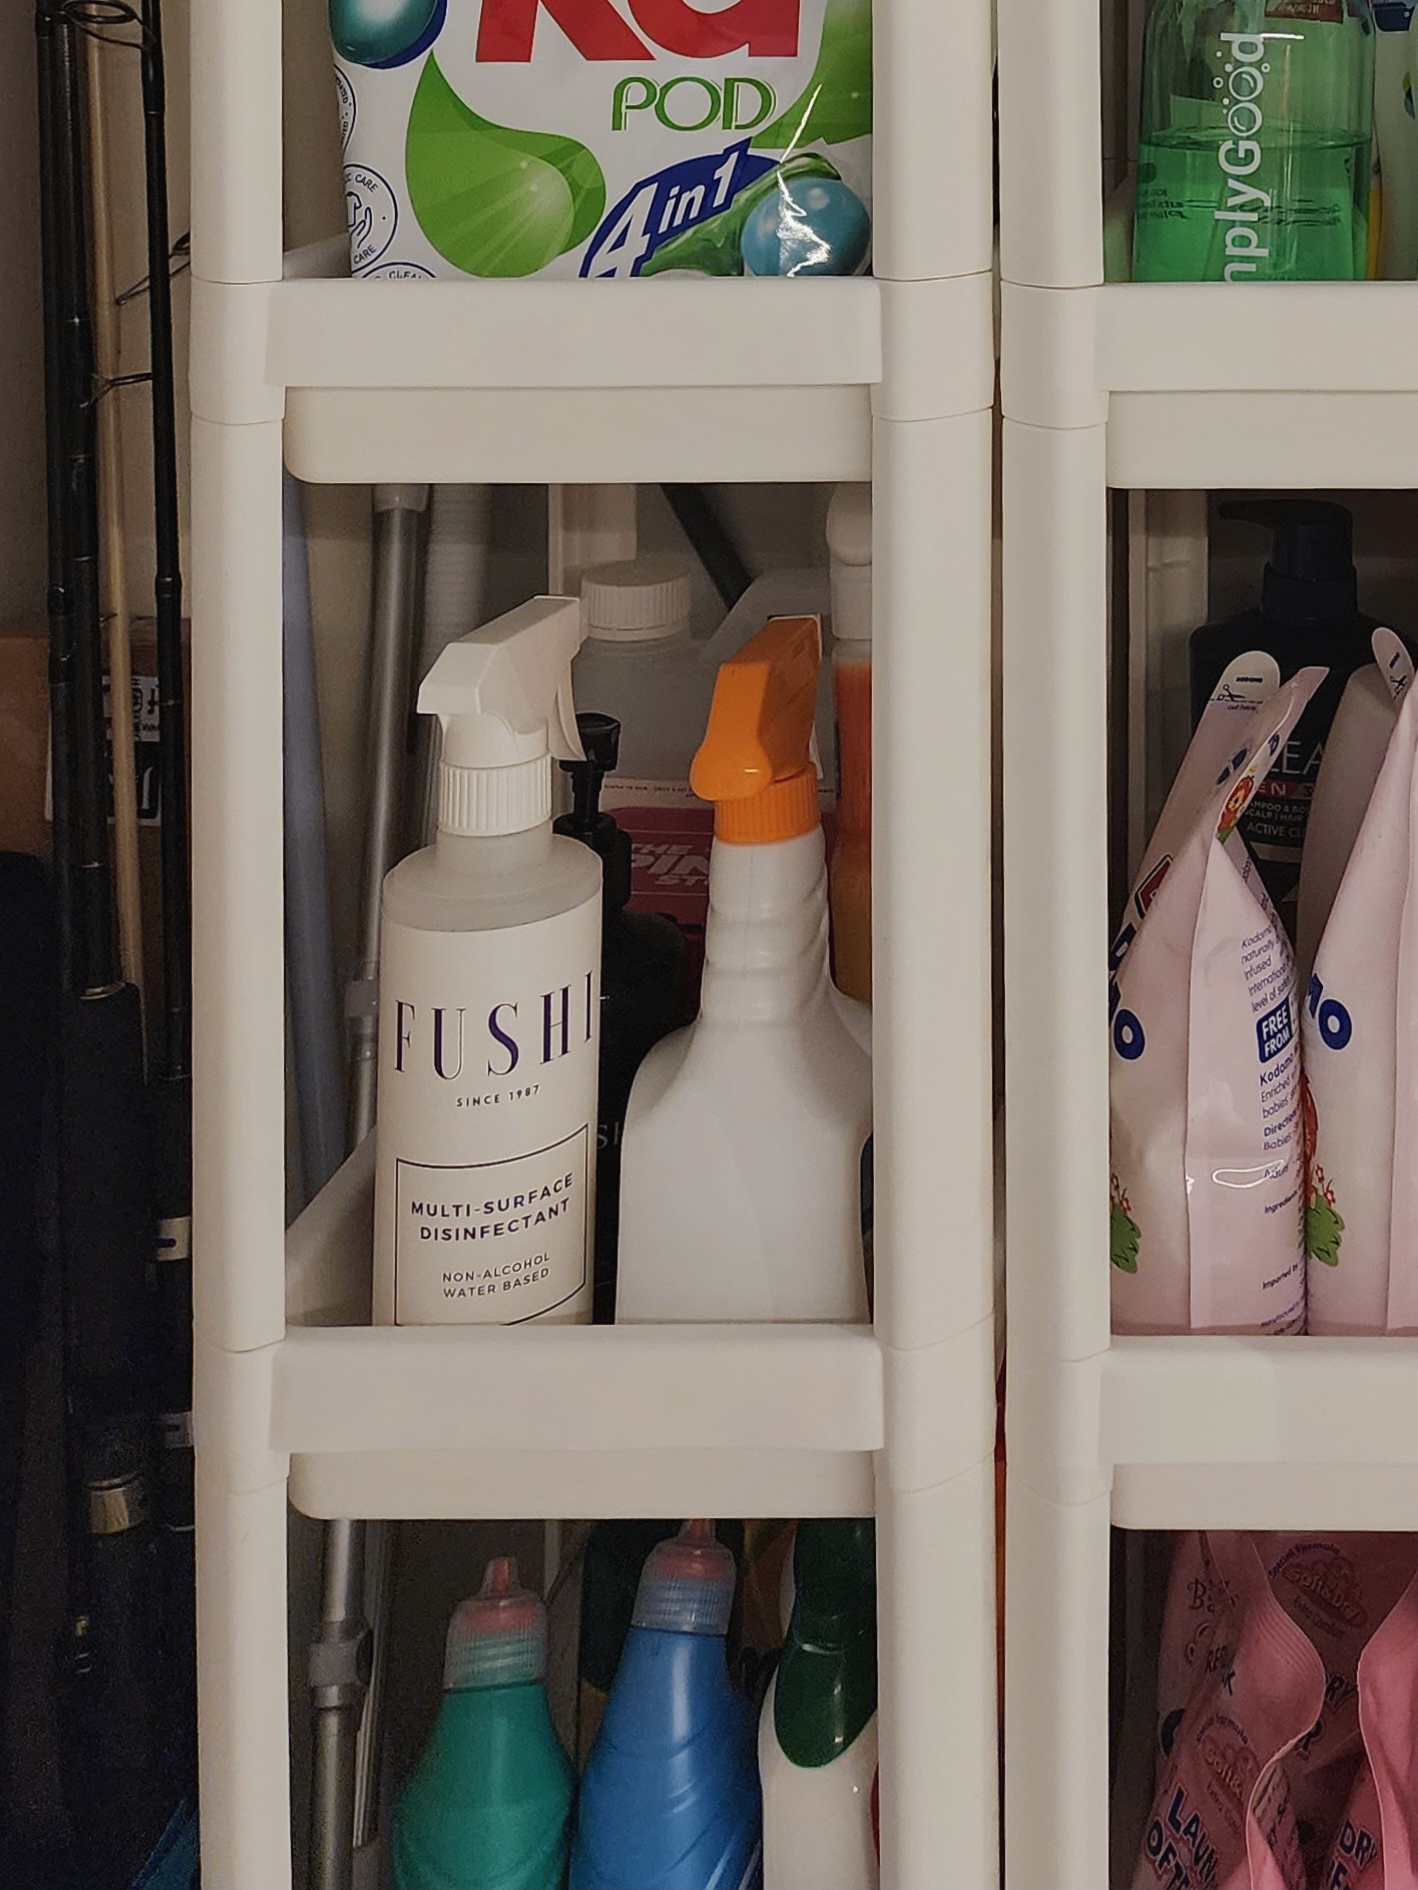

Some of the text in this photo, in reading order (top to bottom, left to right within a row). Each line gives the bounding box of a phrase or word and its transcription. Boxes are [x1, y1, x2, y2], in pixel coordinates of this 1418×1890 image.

[611, 76, 776, 131] POD
[354, 173, 379, 194] CARE
[353, 245, 377, 265] CARE
[1257, 782, 1287, 797] EN
[1245, 807, 1273, 819] CALP
[1250, 800, 1282, 813] AMPOO
[1246, 821, 1287, 837] ACTIVE
[1251, 993, 1269, 1013] level
[394, 969, 594, 1081] FUSHI
[1261, 1003, 1289, 1042] FREE
[1263, 1026, 1291, 1058] FROM
[456, 1083, 541, 1108] SINCE 1987
[1260, 1076, 1292, 1104] Enriched
[1263, 1131, 1293, 1152] Babies
[411, 1171, 574, 1218] MULTI-SURFACE
[420, 1197, 570, 1242] DISINFECTANT
[442, 1252, 551, 1283] NON-ALCOHOL
[443, 1267, 550, 1299] WATER BASED
[1324, 1672, 1356, 1710] RY
[1167, 1784, 1218, 1889] LAUN
